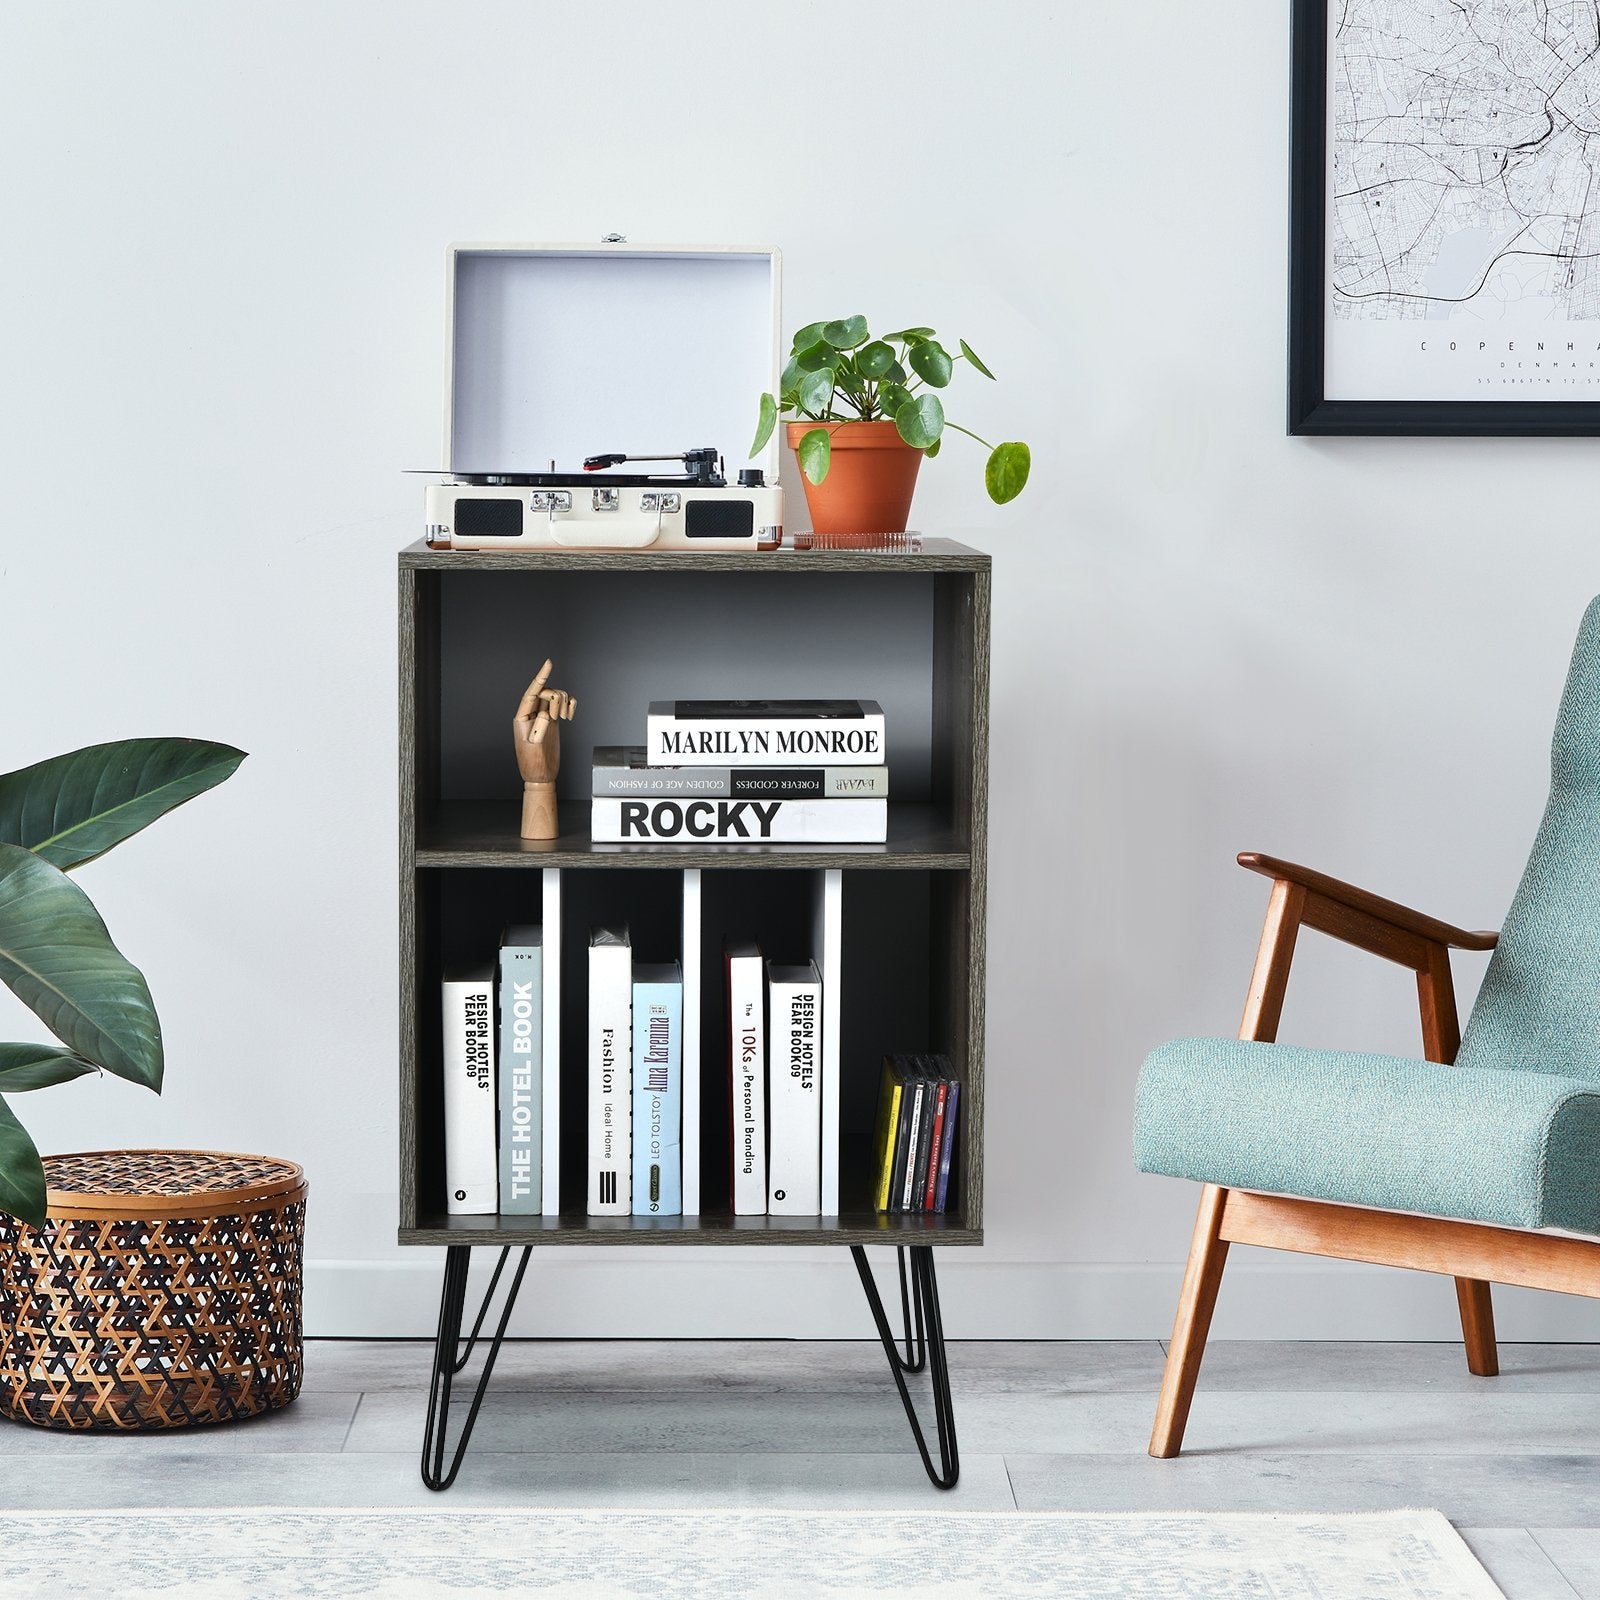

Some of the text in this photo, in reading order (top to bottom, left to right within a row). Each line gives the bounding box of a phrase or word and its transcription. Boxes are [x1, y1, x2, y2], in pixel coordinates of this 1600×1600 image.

[662, 731, 878, 753] MARILYN MONROE
[609, 780, 724, 789] GOLDEN AGE OF FASHION
[736, 780, 819, 789] FOREVER GODDESS
[836, 780, 875, 791] BAZAAR
[620, 802, 782, 838] ROCKY
[464, 995, 477, 1077] YEAR BOOK09
[476, 995, 488, 1037] DESIGN
[791, 995, 802, 1077] YEAR BOOK09
[803, 995, 814, 1037] DESIGN
[603, 1029, 615, 1093] Fashion
[644, 1018, 670, 1063] Karenina
[743, 1027, 756, 1062] 10Ks
[644, 1068, 669, 1093] Anna
[743, 1065, 750, 1073] of
[512, 982, 533, 1199] THE HOTEL BOOK
[744, 1075, 755, 1123] Personal
[605, 1104, 613, 1158] Ideal Home
[651, 1095, 661, 1159] LEO TOLSTOY
[743, 1128, 755, 1173] Branding
